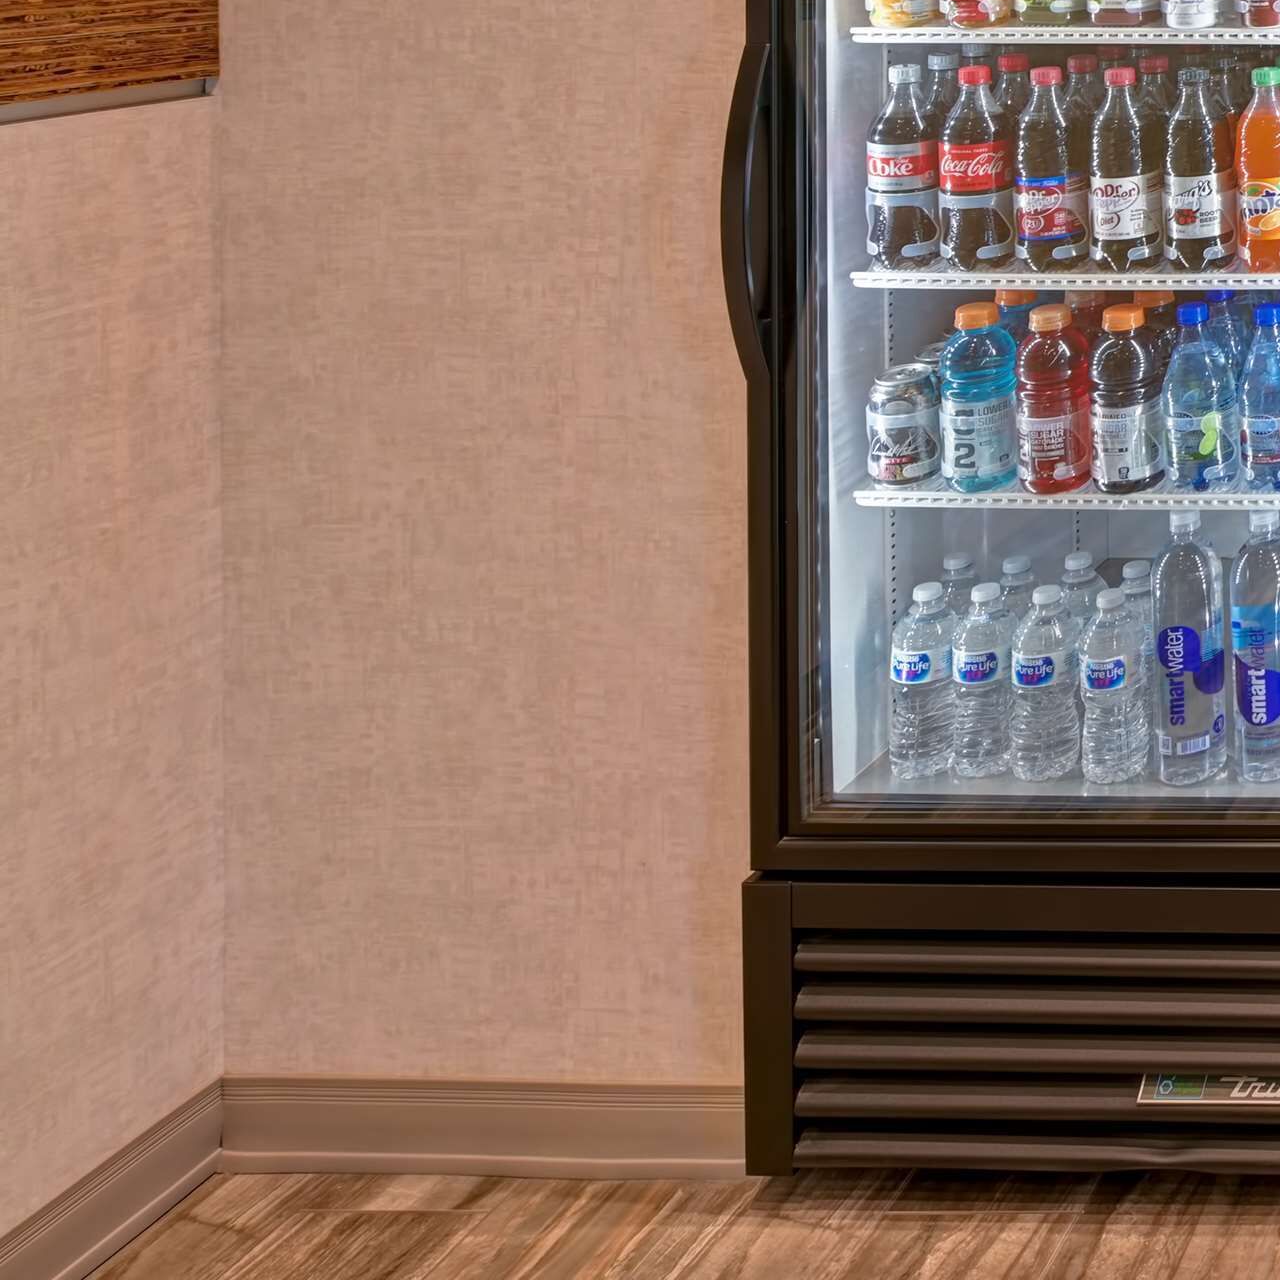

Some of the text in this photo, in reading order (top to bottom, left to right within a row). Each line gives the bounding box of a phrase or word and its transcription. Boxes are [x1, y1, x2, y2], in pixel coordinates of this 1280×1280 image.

[940, 151, 1005, 177] Coca-Cola
[910, 660, 929, 672] Life
[977, 660, 998, 672] Life
[1034, 664, 1053, 675] Life
[1105, 666, 1124, 679] Life
